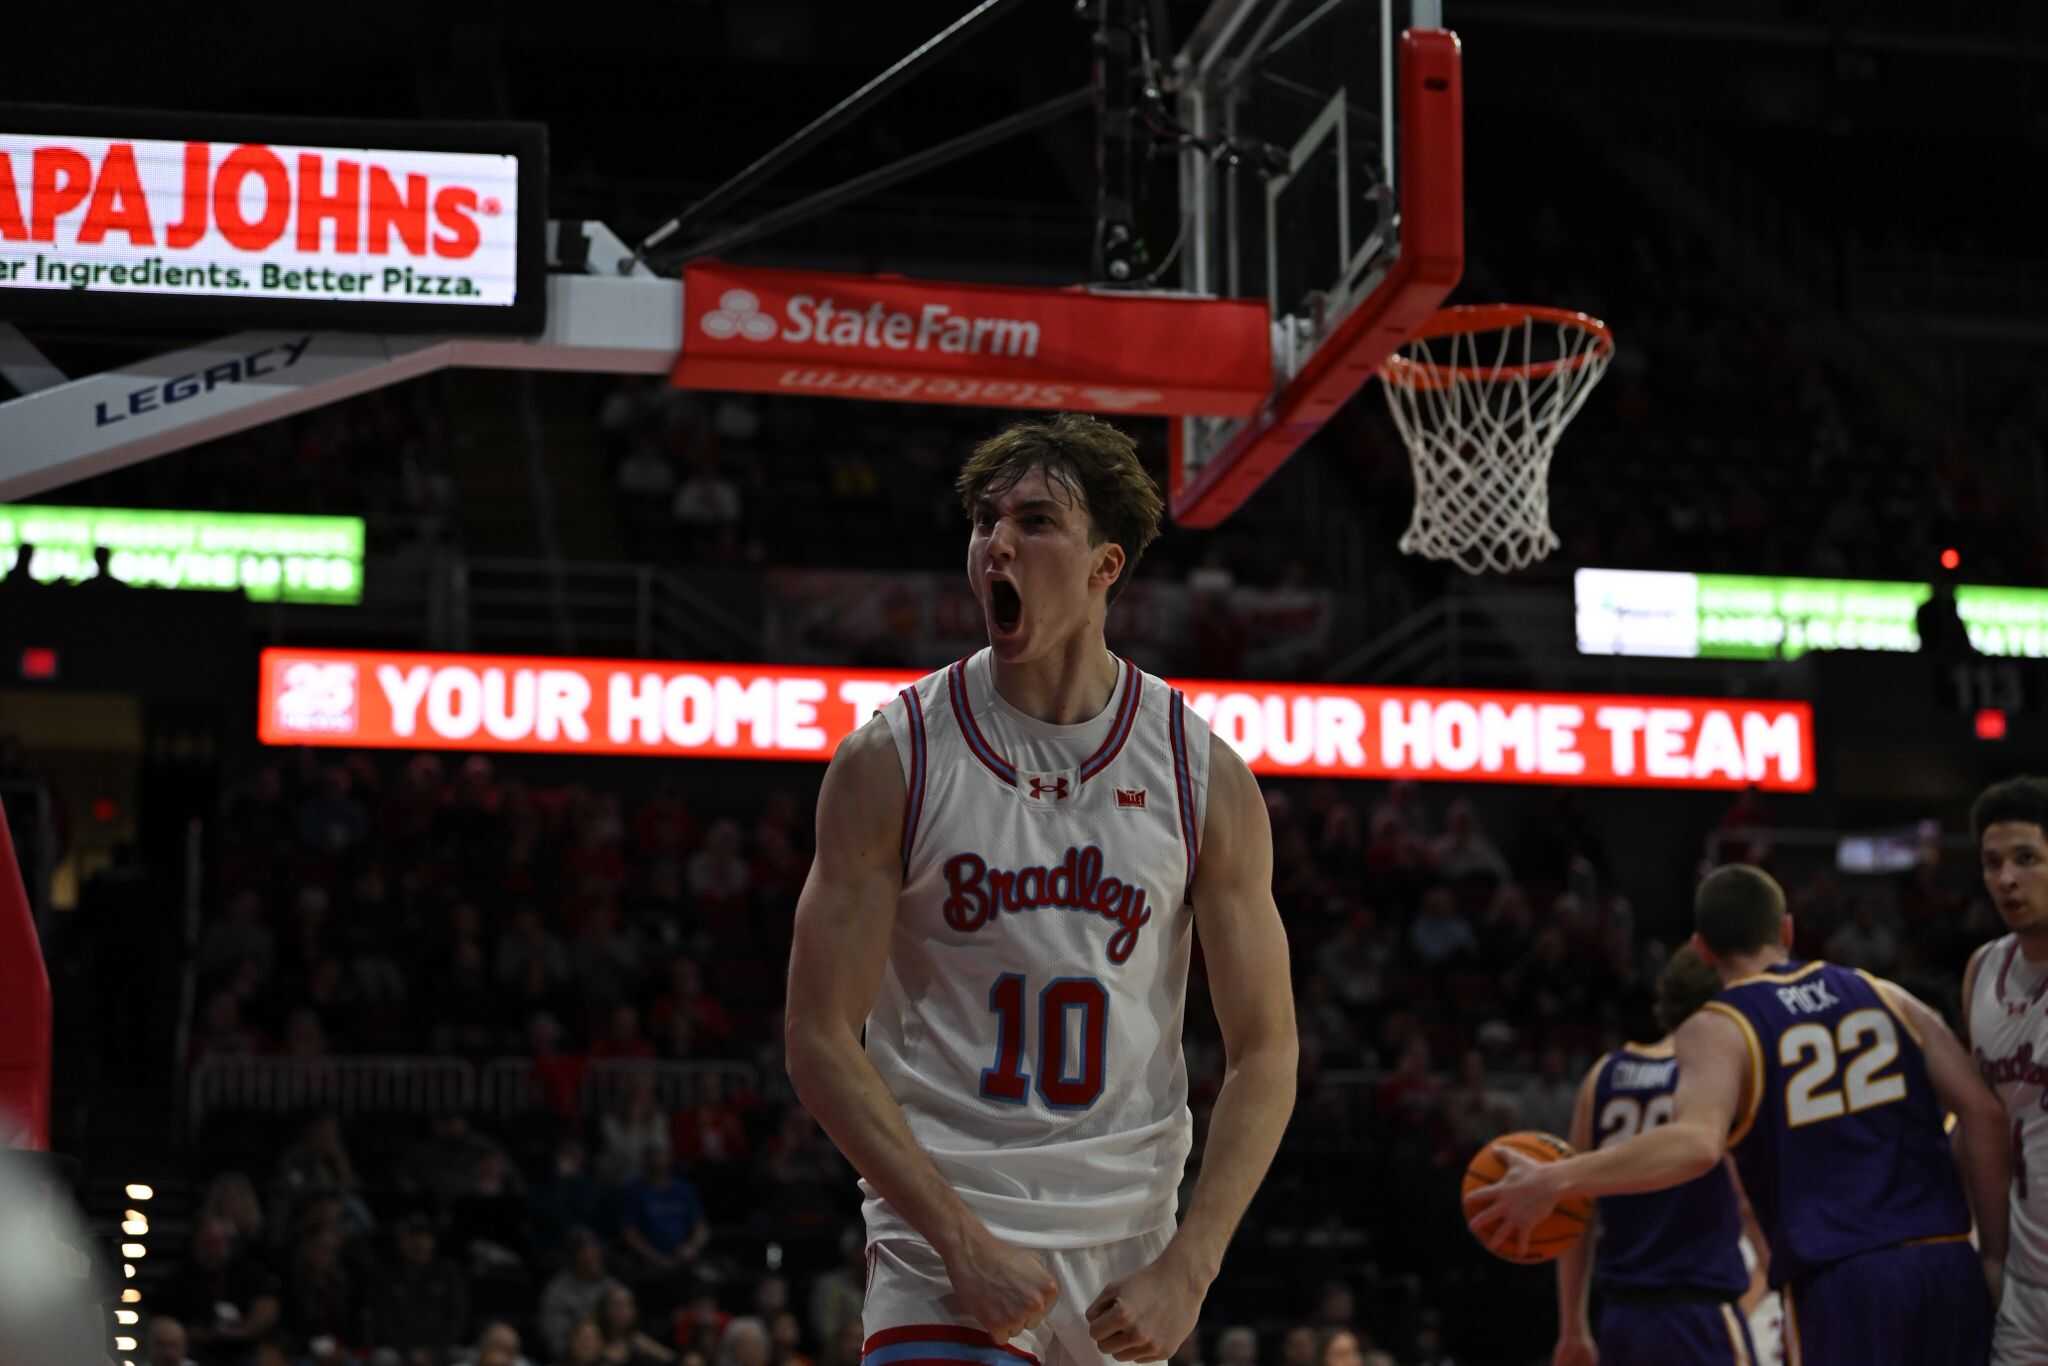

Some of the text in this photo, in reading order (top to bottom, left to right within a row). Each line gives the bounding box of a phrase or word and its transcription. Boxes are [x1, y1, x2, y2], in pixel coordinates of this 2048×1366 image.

[36, 254, 250, 291] Ingredients.
[262, 262, 373, 293] Better
[383, 266, 482, 296] Pizza.
[95, 336, 313, 427] LEGACY
[376, 664, 591, 742] YOUR
[607, 669, 829, 751] HOME
[1379, 697, 1587, 773] HOME
[1595, 704, 1802, 784] TEAM
[943, 846, 1151, 965] Bradley
[979, 972, 1109, 1111] 10
[1778, 1008, 1908, 1130] 22
